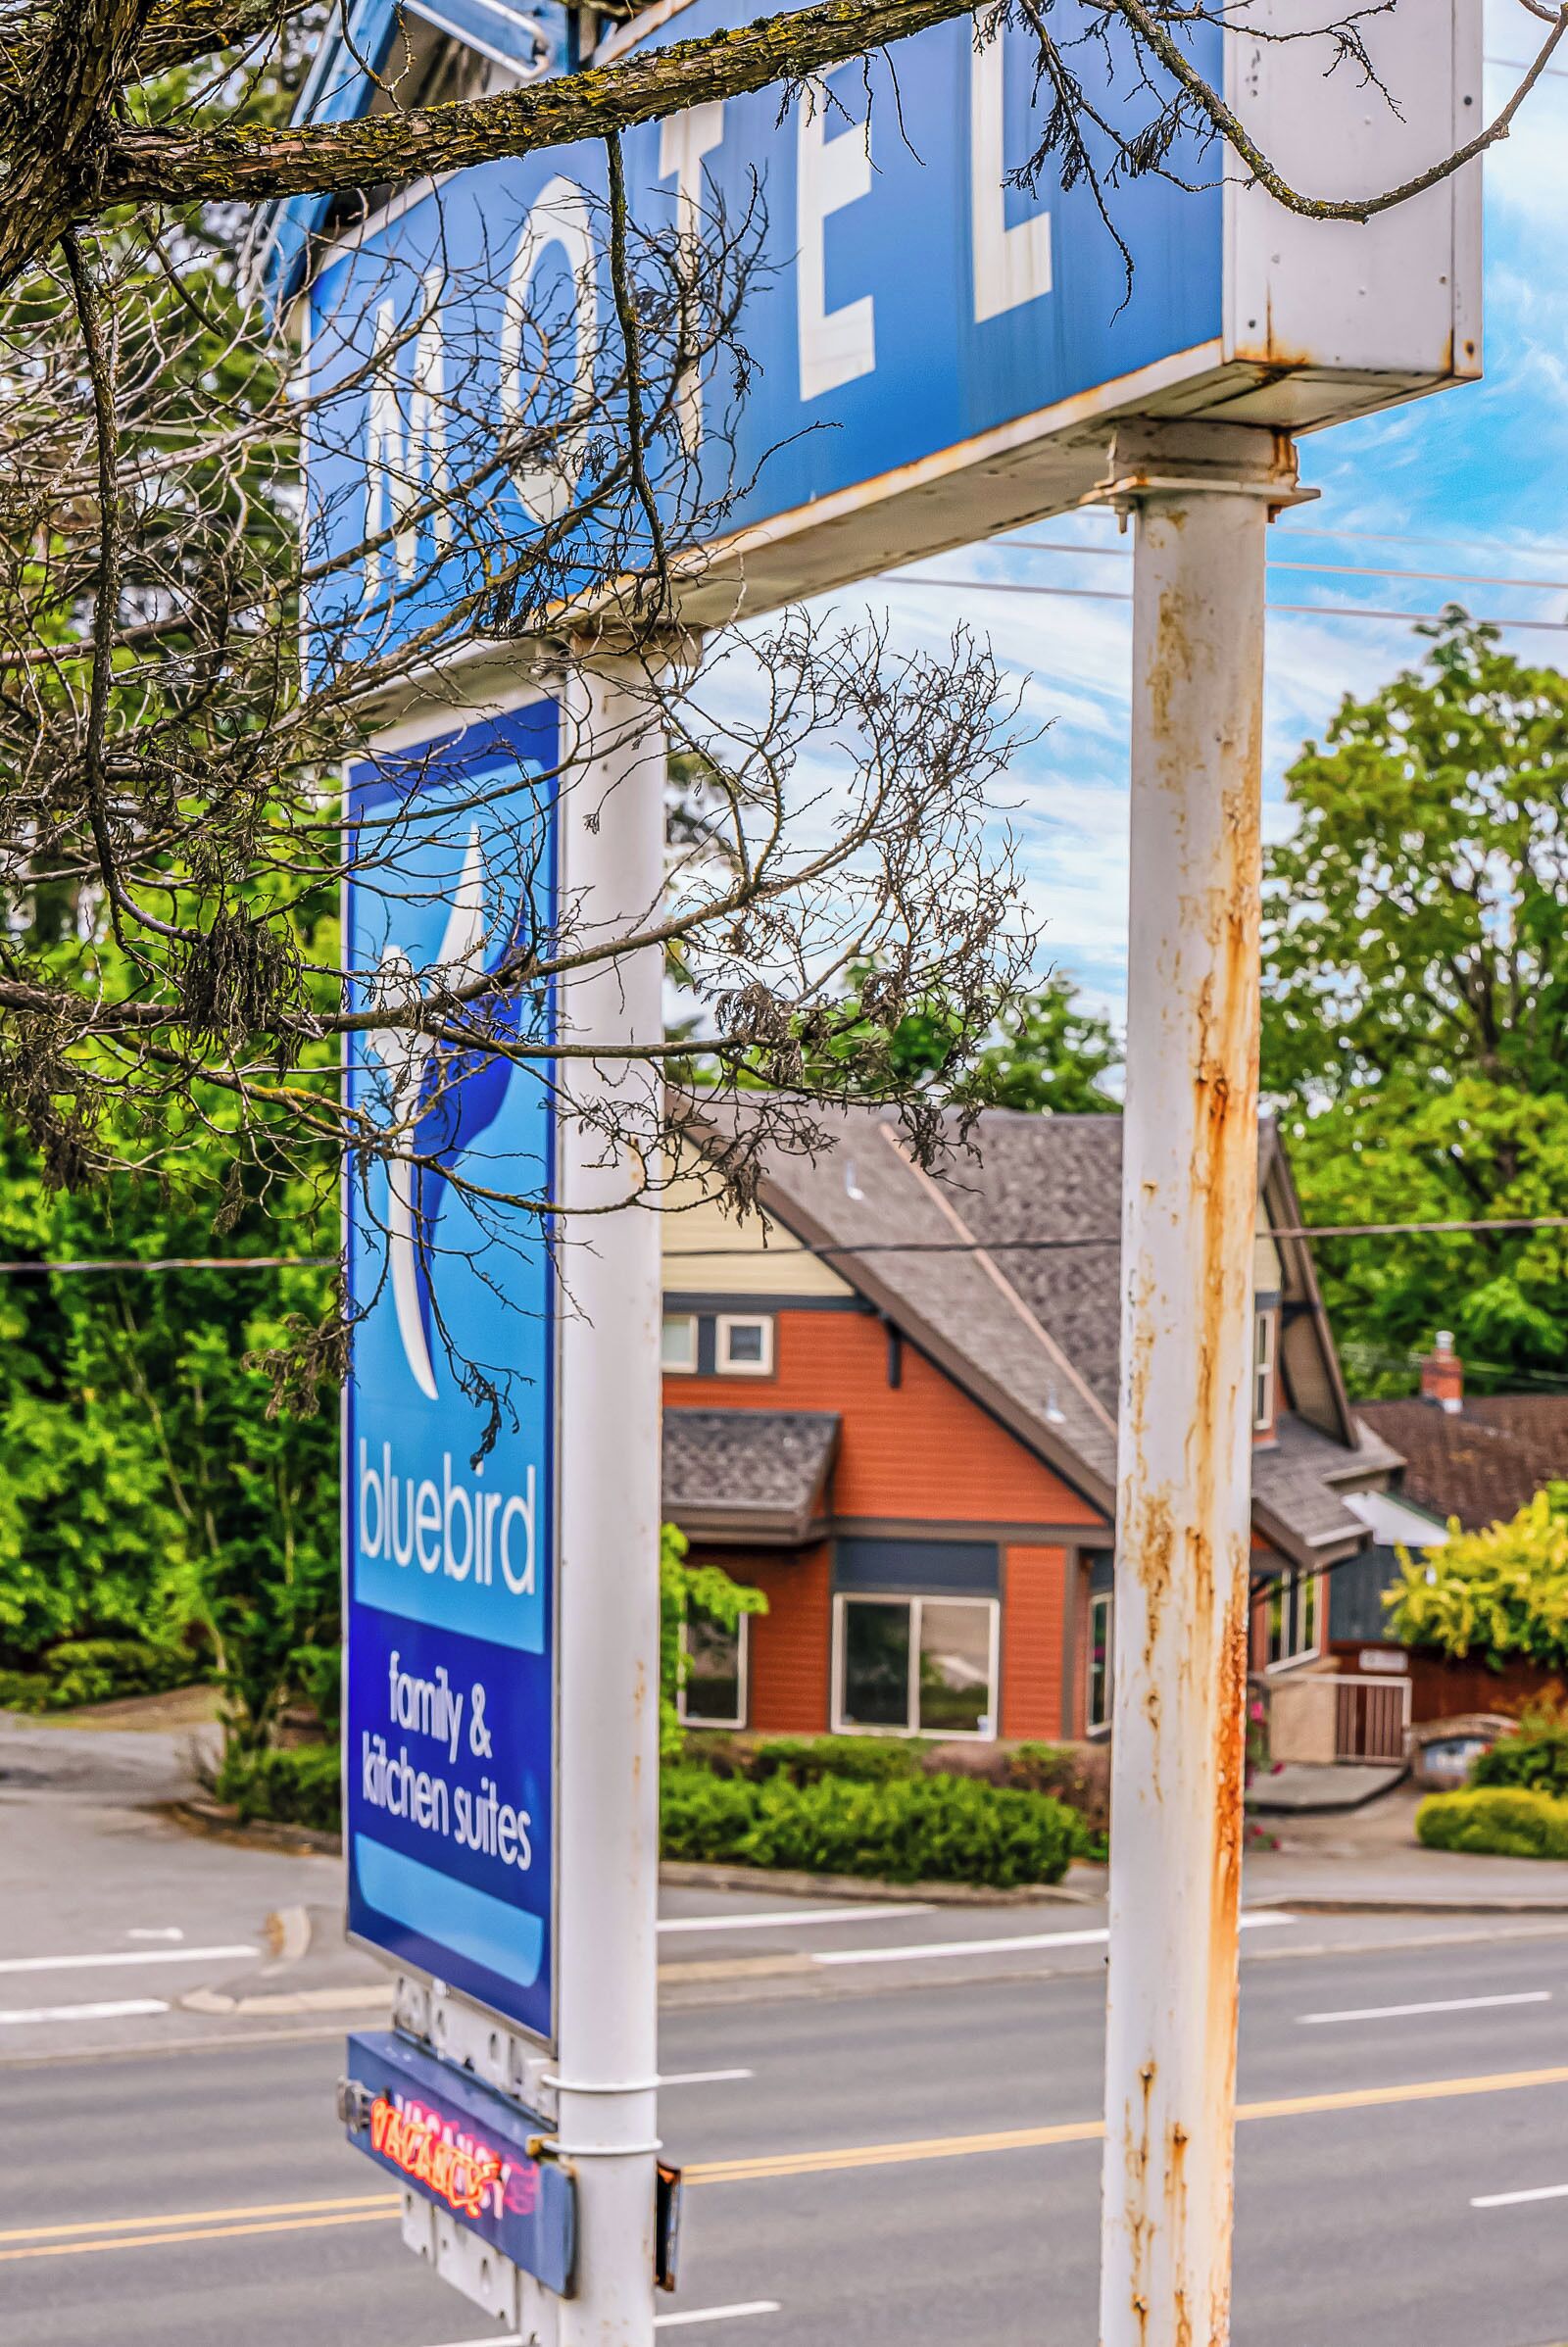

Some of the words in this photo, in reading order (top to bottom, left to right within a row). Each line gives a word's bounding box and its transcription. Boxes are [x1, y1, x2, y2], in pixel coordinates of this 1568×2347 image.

[363, 0, 1054, 602] MOTEL
[359, 1438, 536, 1595] bluebird
[389, 1650, 464, 1763] family
[469, 1683, 493, 1758] &
[362, 1731, 450, 1835] kitchen
[454, 1777, 532, 1871] suites
